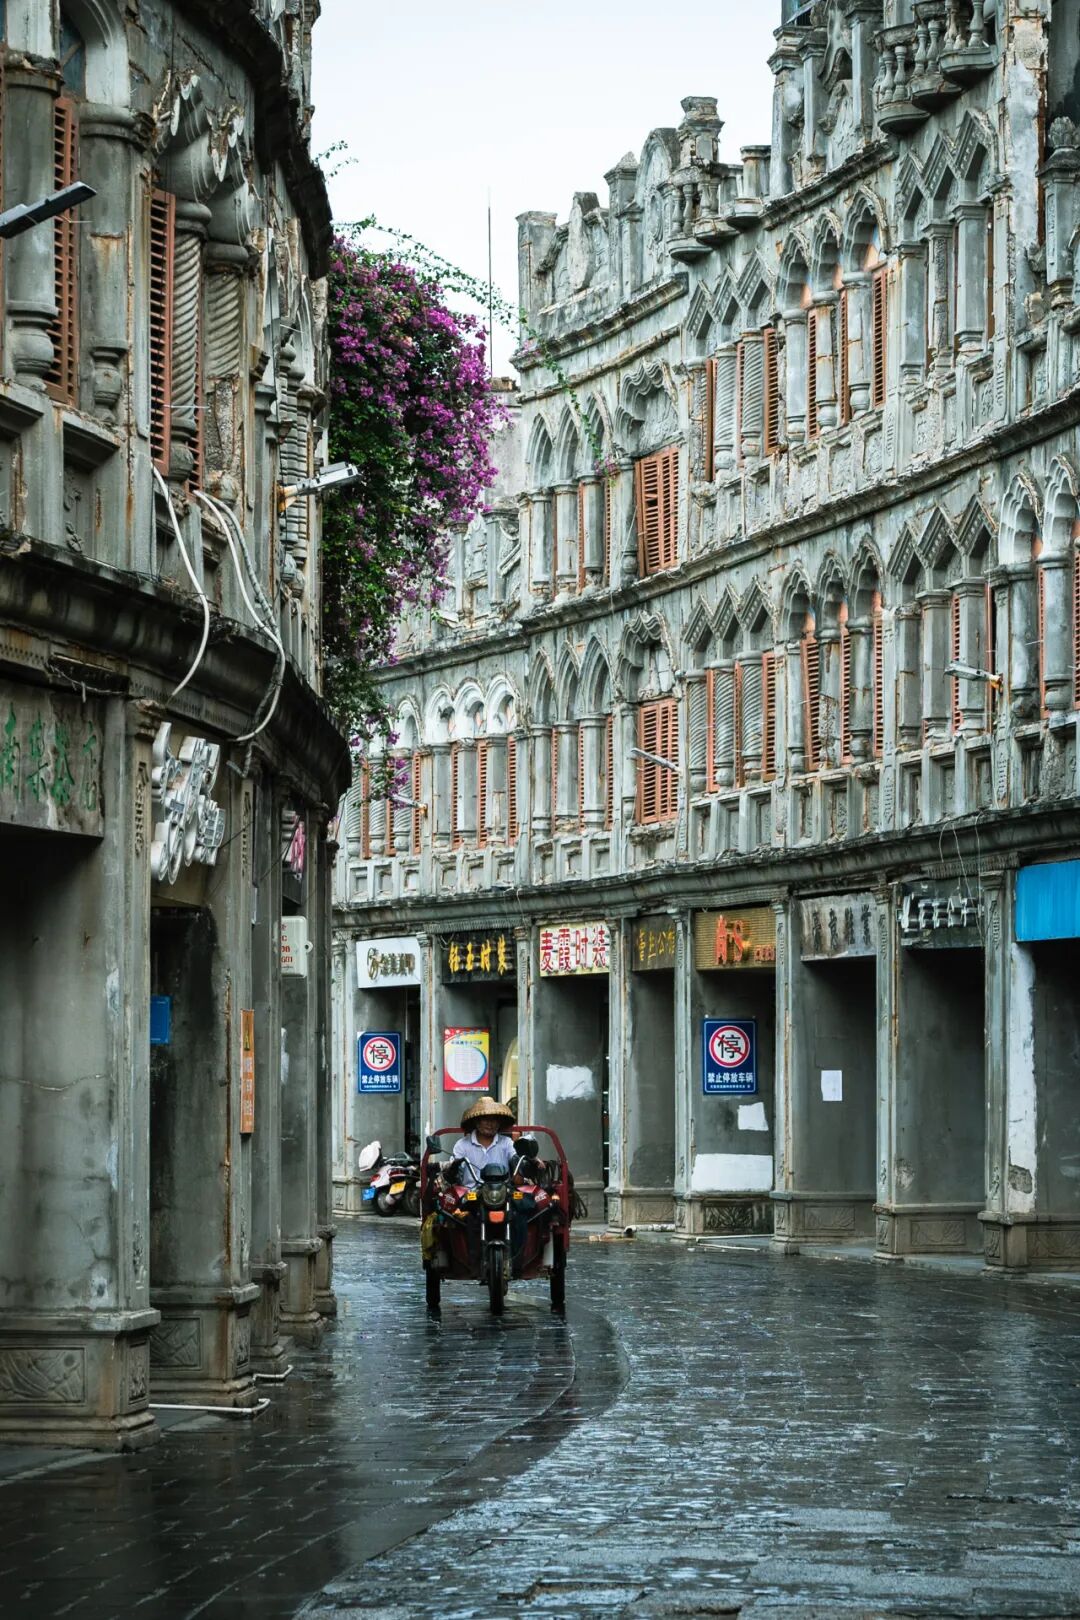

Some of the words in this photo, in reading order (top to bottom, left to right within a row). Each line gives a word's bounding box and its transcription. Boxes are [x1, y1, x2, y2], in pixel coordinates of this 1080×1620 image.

[540, 924, 606, 971] 麦霞时装
[361, 1074, 399, 1084] 禁止停放车辆
[707, 1072, 754, 1084] 禁止停放车辆
